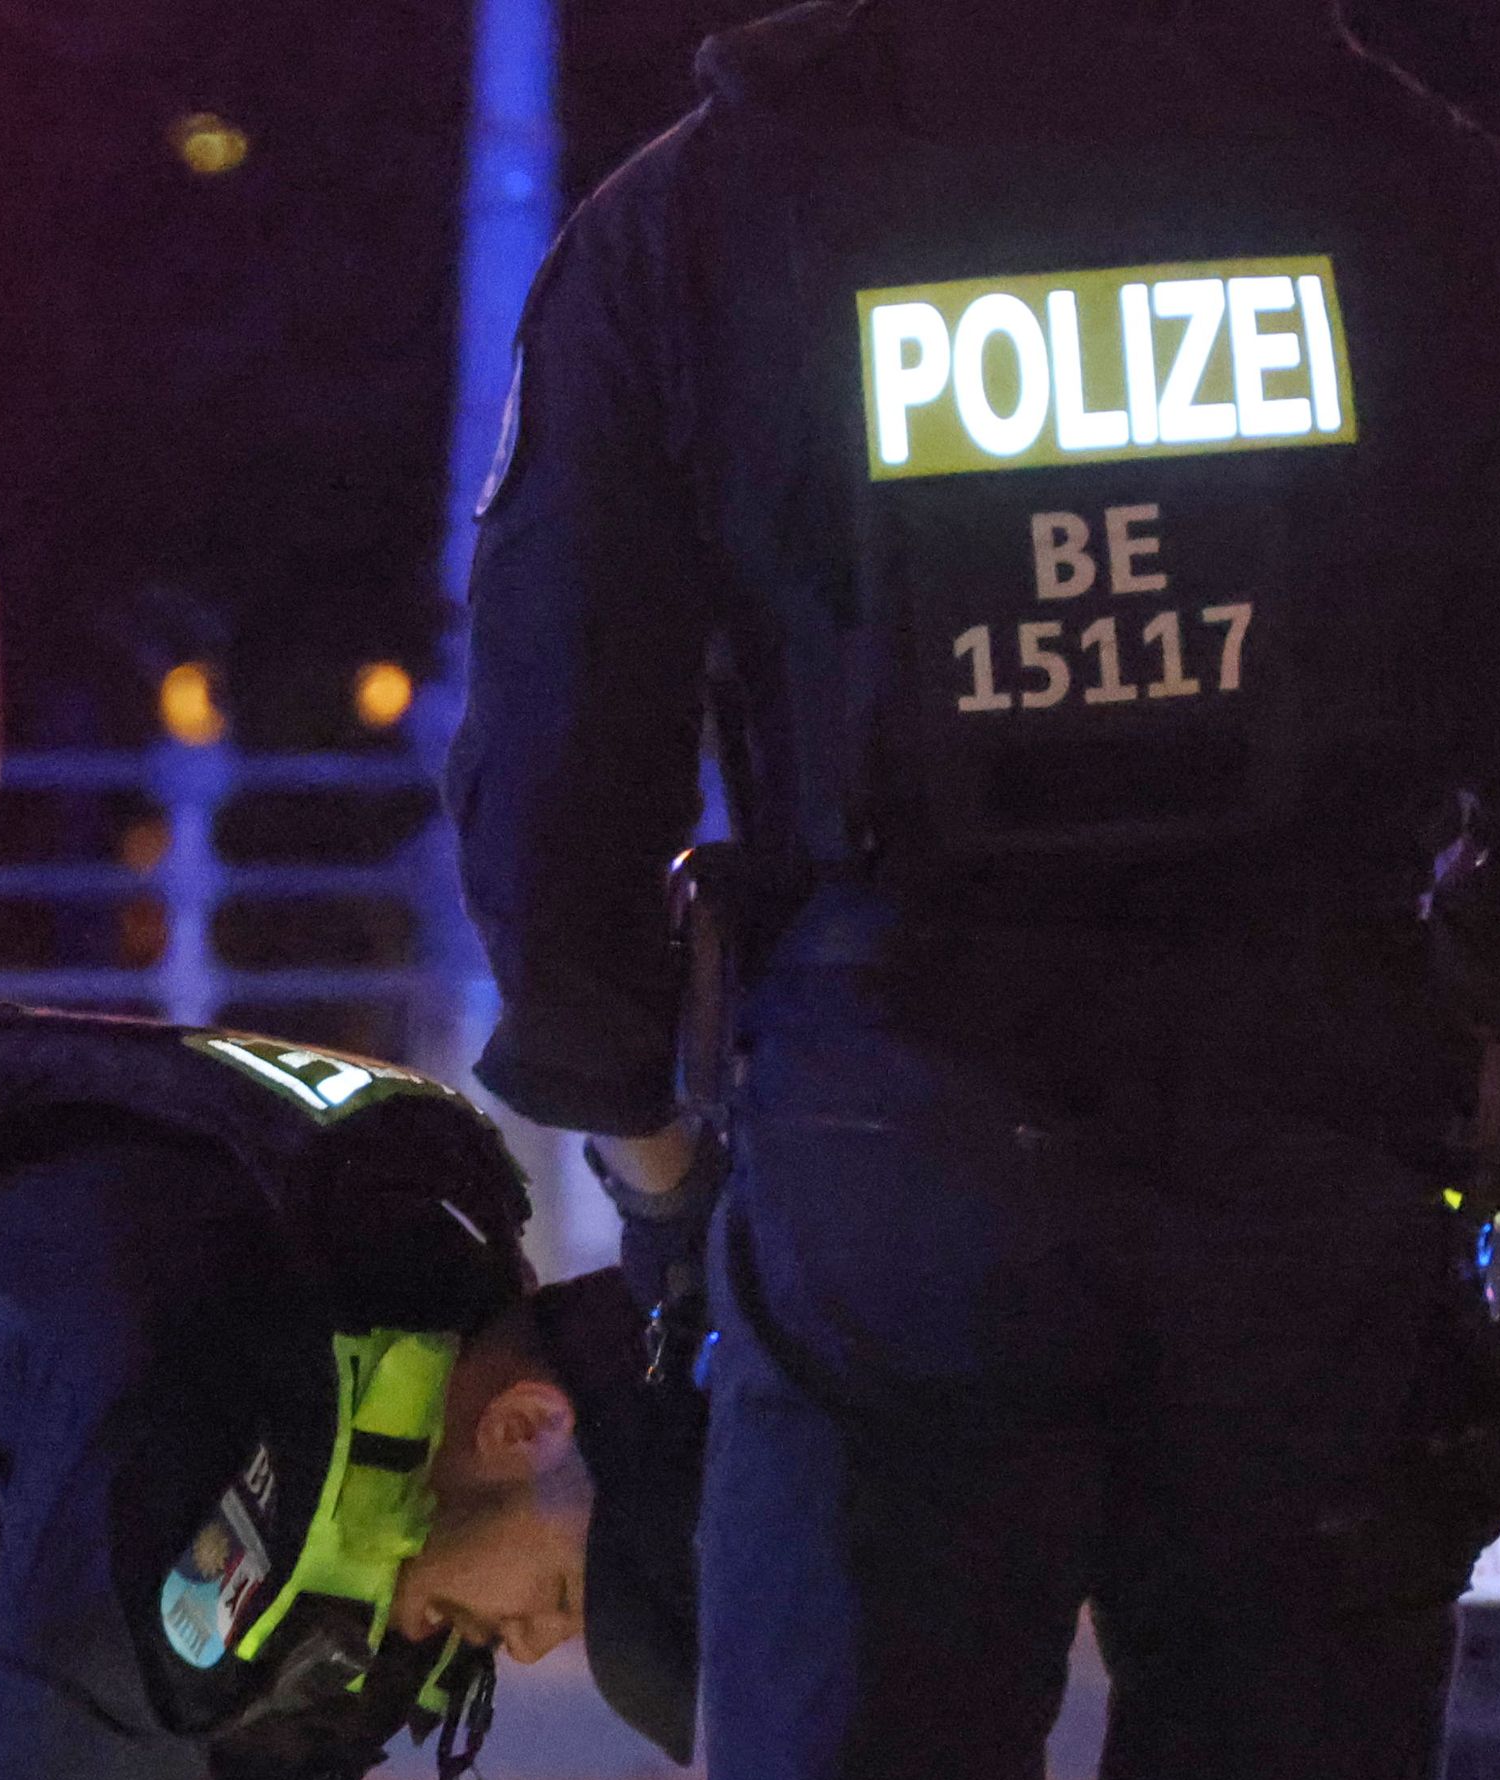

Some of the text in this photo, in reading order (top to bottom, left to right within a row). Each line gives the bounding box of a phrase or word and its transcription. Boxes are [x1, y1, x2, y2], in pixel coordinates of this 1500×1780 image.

[870, 273, 1342, 466] POLIZEI
[1029, 502, 1170, 602] BE
[952, 602, 1254, 714] 15117
